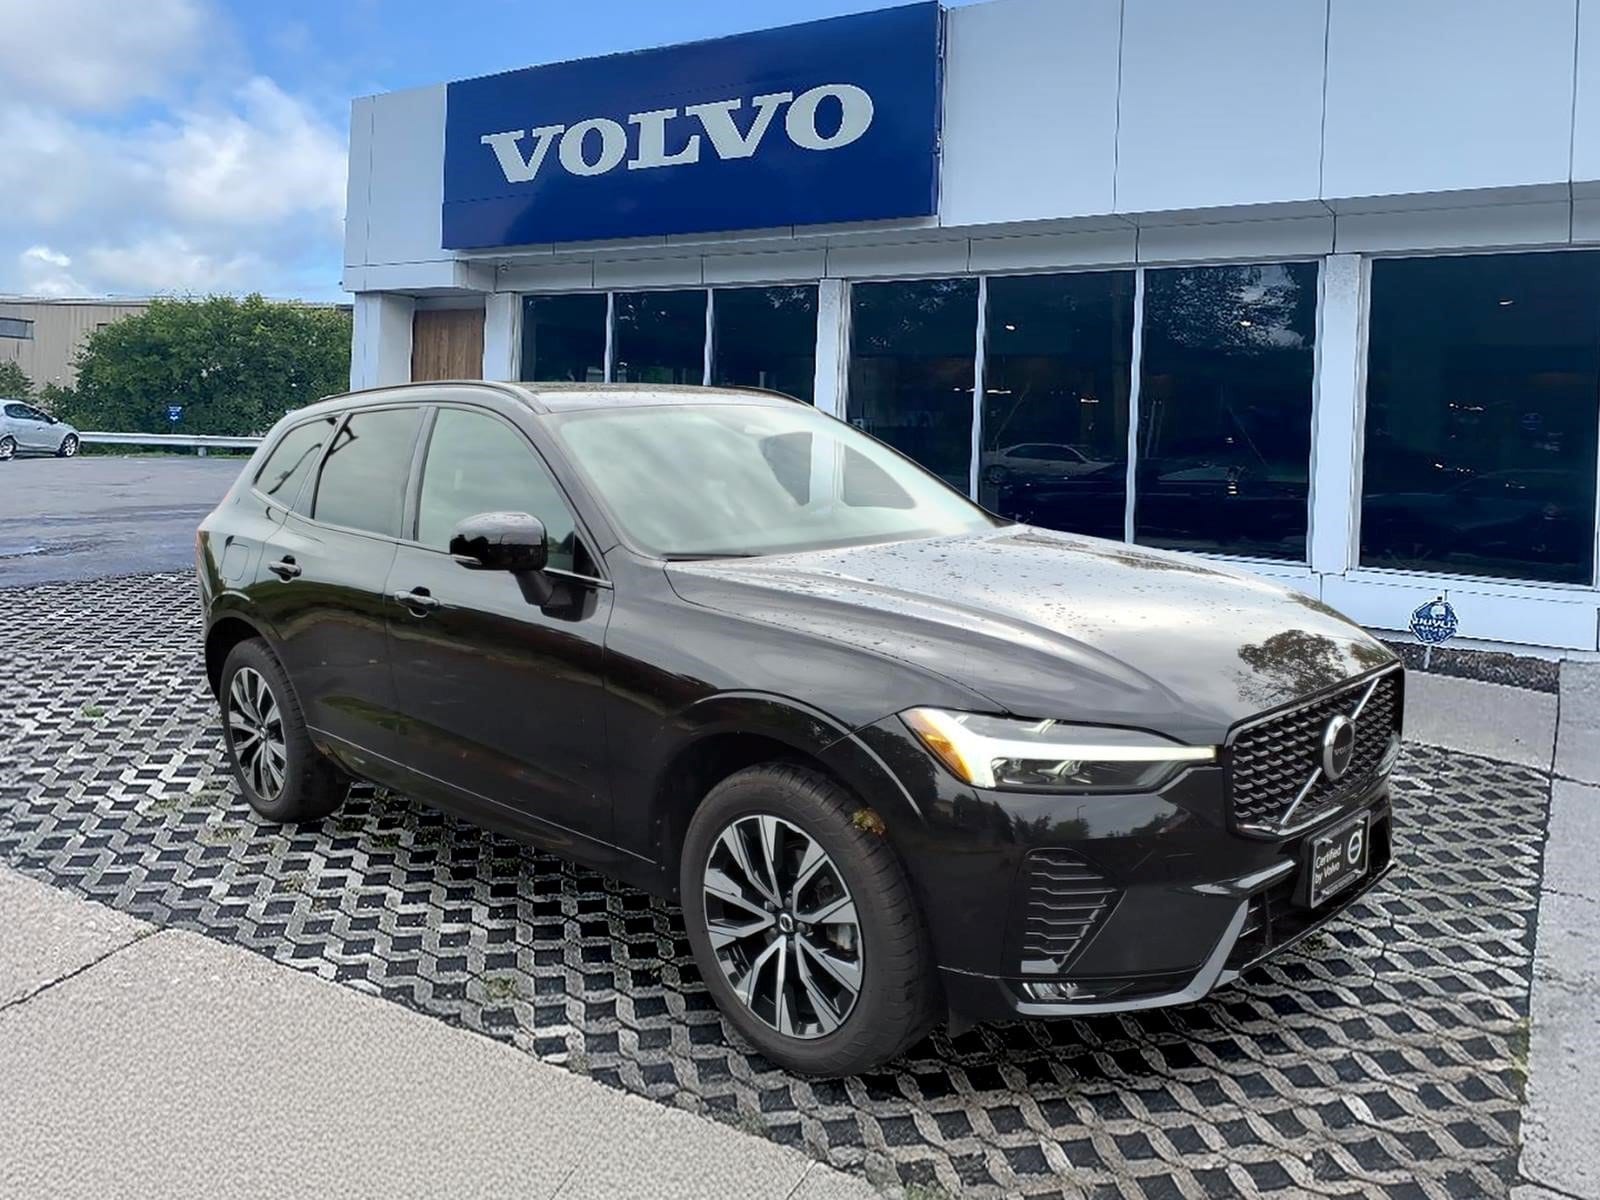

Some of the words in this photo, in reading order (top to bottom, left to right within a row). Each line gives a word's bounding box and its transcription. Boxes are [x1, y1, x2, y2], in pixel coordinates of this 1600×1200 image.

[481, 84, 874, 183] VOLVO
[1316, 843, 1342, 869] Certified
[1315, 873, 1323, 885] by
[1324, 862, 1340, 878] Volvo
